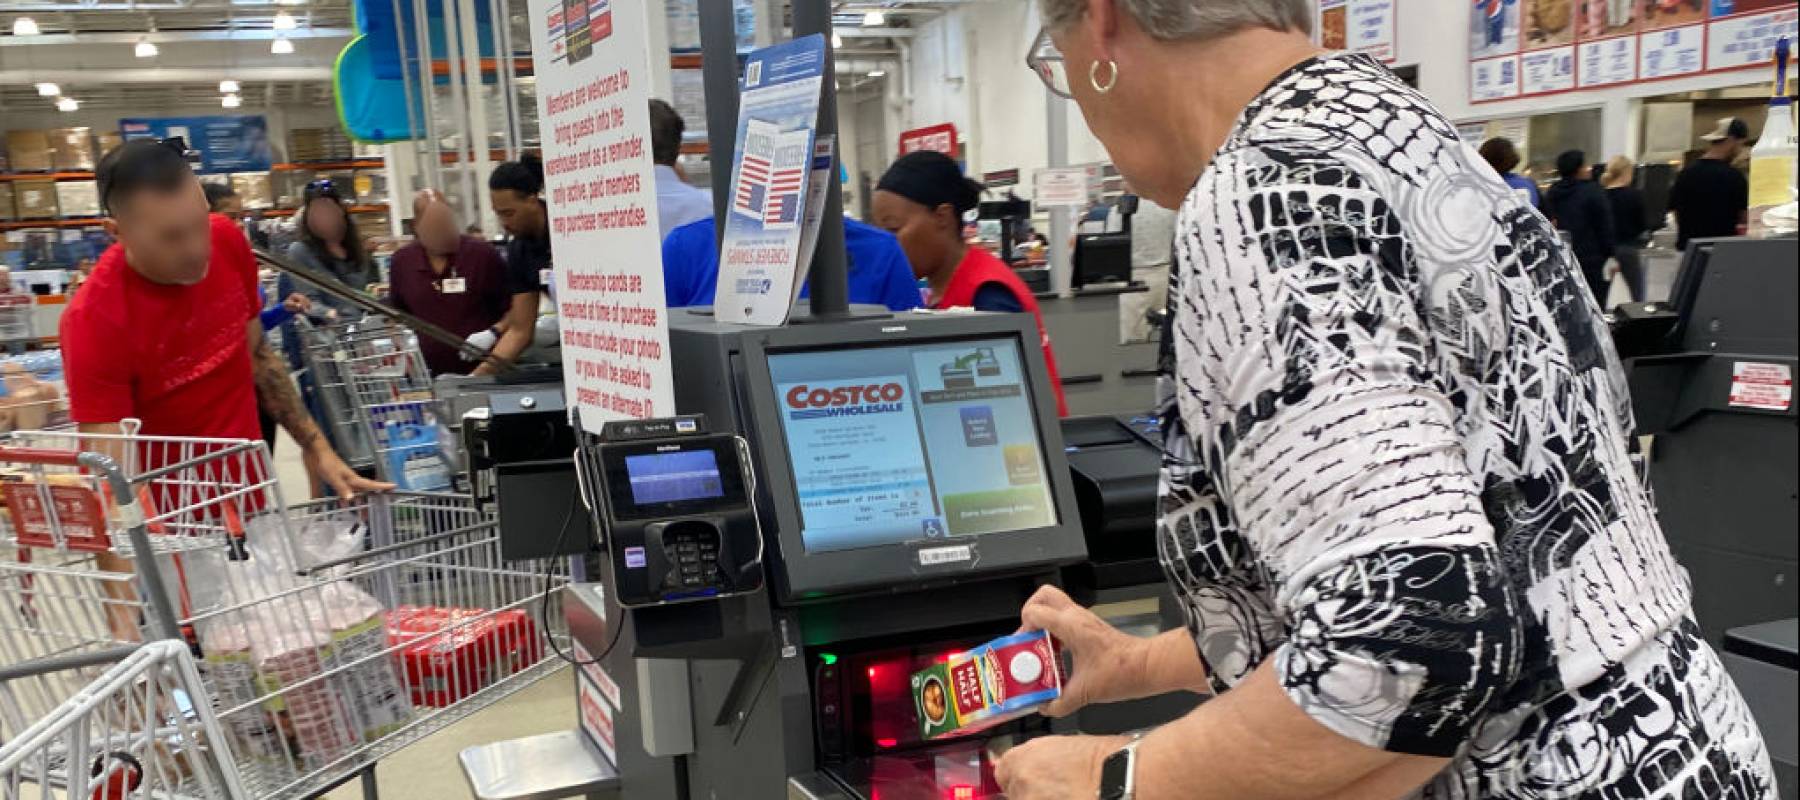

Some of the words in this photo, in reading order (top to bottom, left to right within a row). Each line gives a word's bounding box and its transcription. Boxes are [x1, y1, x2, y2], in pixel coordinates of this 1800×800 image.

[546, 89, 574, 116] Members
[575, 86, 586, 108] are
[587, 73, 619, 102] welcome
[619, 67, 629, 91] to
[555, 122, 571, 147] bring
[571, 114, 594, 146] guests
[595, 110, 610, 133] into
[611, 106, 624, 129] the
[546, 152, 577, 176] warehouse
[578, 145, 591, 169] and
[592, 147, 601, 167] as
[553, 182, 566, 208] only
[589, 174, 605, 205] paid
[605, 173, 640, 196] members
[553, 216, 566, 238] may
[567, 211, 596, 238] purchase
[566, 265, 606, 297] Membership
[607, 268, 628, 292] cards
[629, 274, 642, 293] are
[562, 299, 587, 323] required
[587, 300, 594, 321] at
[595, 300, 610, 322] time
[612, 301, 619, 322] of
[620, 302, 656, 328] purchase
[563, 328, 575, 346] and
[575, 329, 592, 349] must
[593, 330, 617, 353] include
[619, 337, 636, 360] your
[637, 336, 661, 362] photo
[575, 358, 582, 375] or
[584, 360, 596, 380] you
[596, 358, 609, 379] will
[609, 361, 618, 382] be
[620, 364, 642, 387] asked
[642, 368, 652, 390] to
[576, 387, 601, 406] present
[601, 392, 610, 408] an
[611, 391, 643, 417] alternate
[786, 382, 904, 409] COSTCO
[826, 402, 904, 417] WHOLESALE
[957, 670, 971, 707] HALF
[967, 666, 982, 703] HALF
